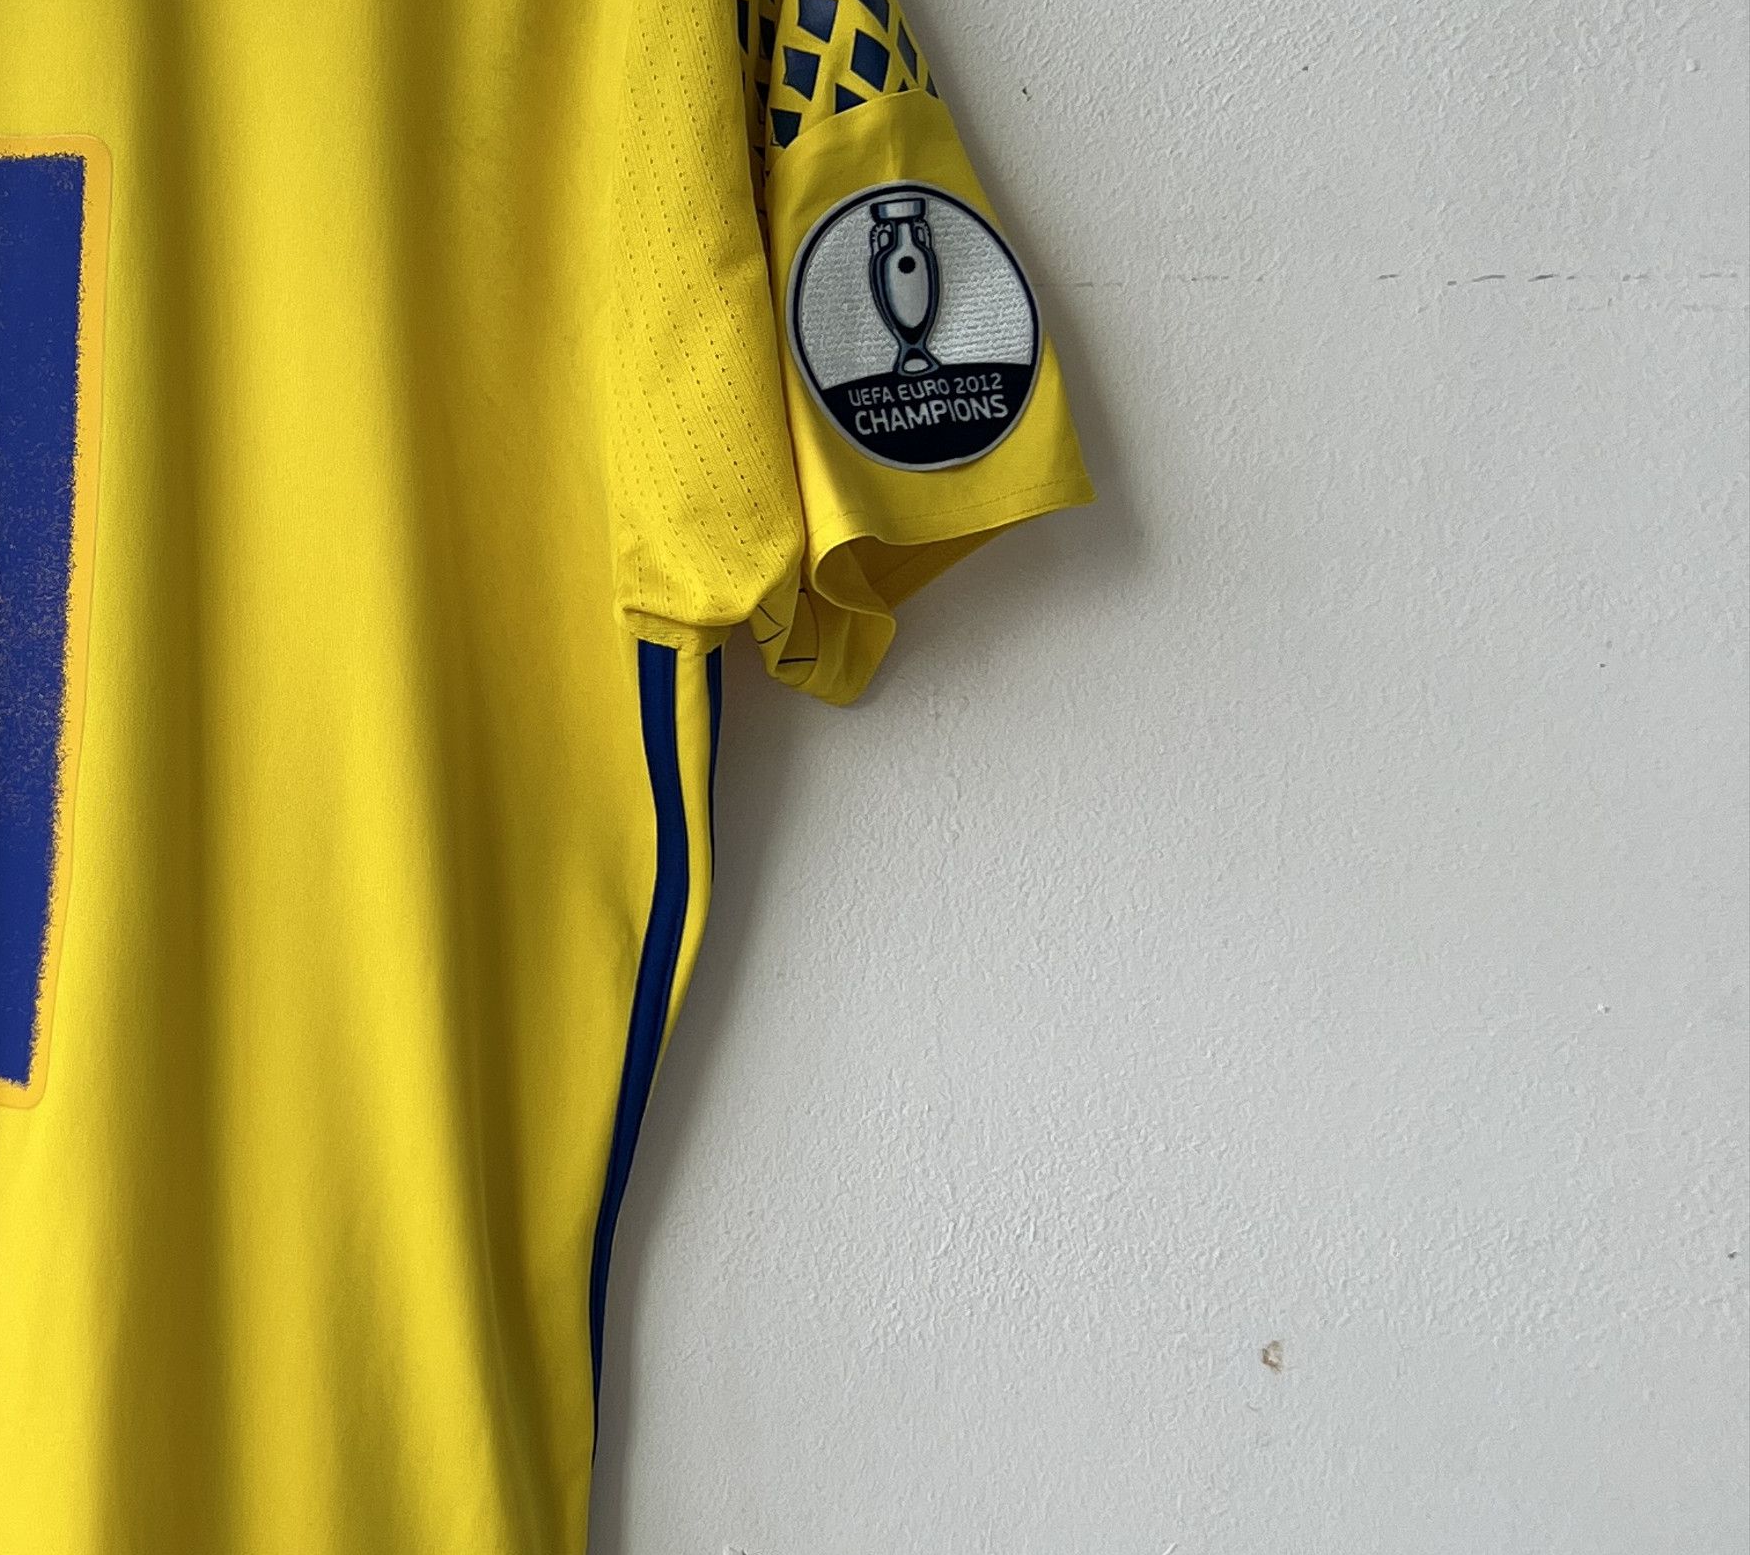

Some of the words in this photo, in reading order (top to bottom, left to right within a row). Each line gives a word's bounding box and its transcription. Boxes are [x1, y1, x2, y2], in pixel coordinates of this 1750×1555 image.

[848, 387, 895, 407] UEFA
[898, 378, 950, 401] EURO
[953, 372, 1003, 394] 2012
[855, 394, 1009, 435] CHAMPIONS
